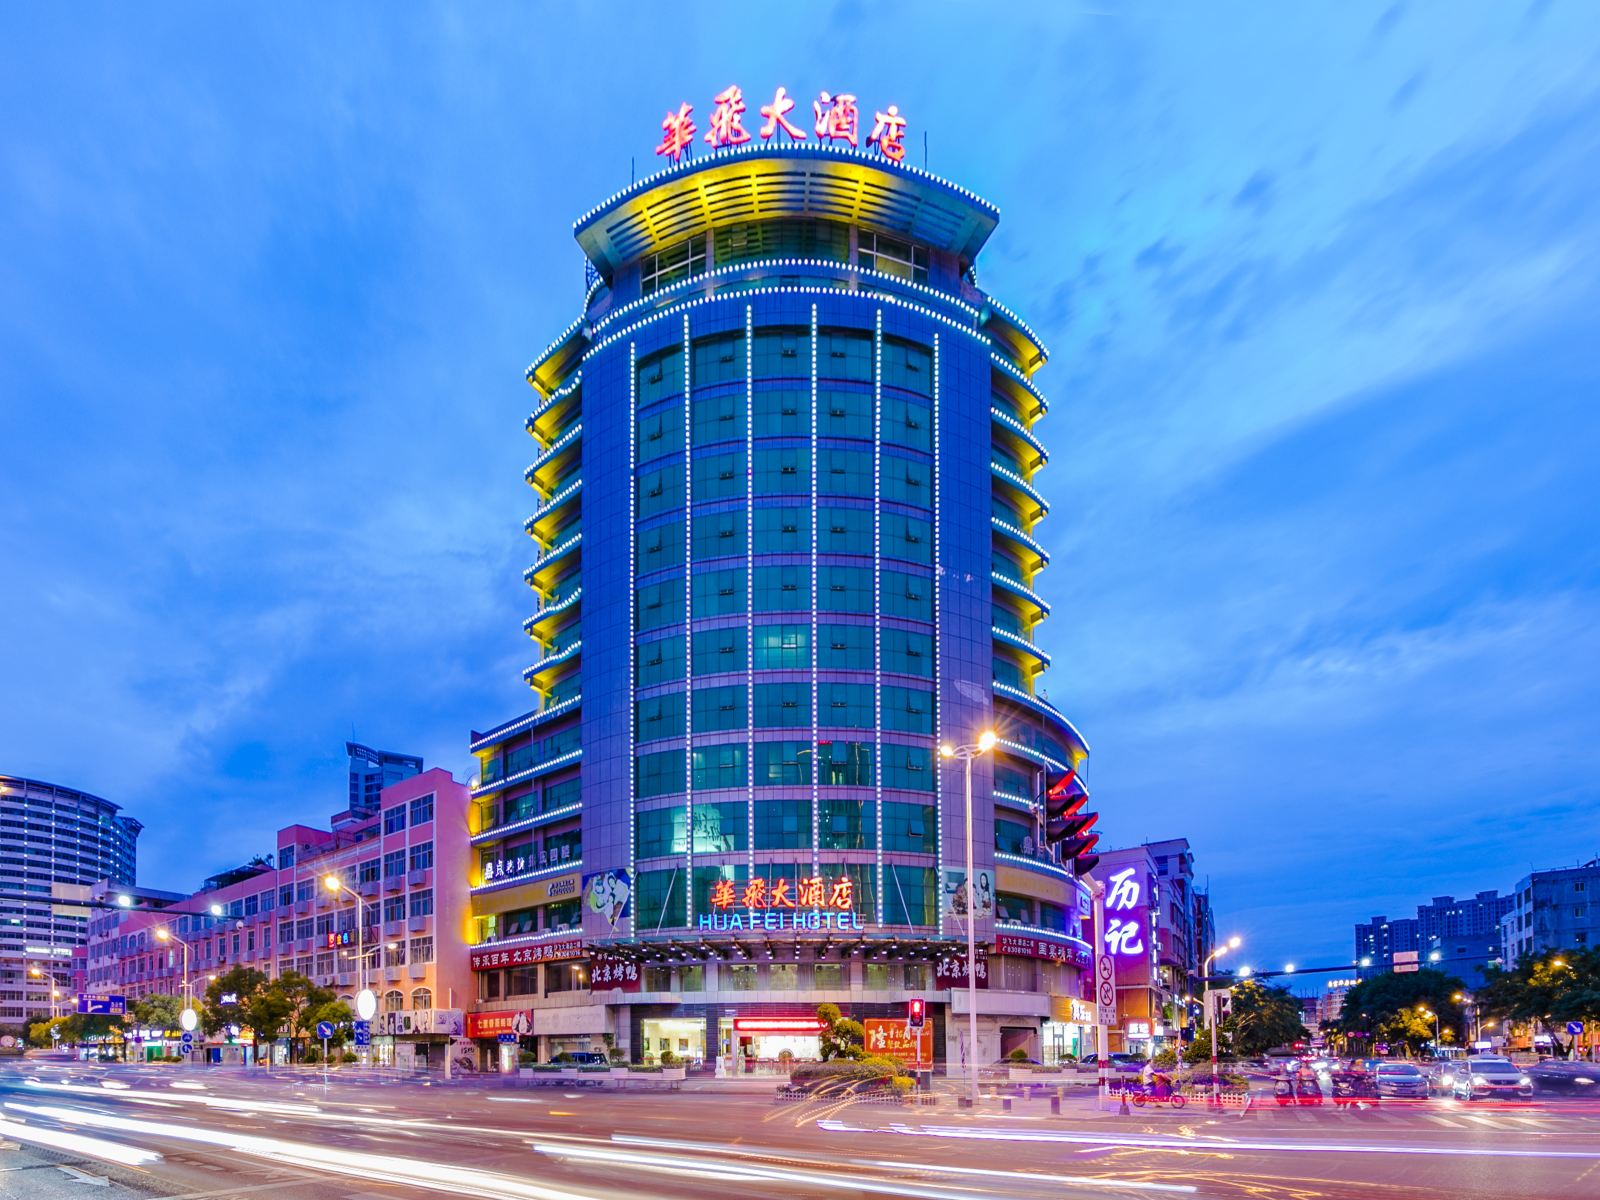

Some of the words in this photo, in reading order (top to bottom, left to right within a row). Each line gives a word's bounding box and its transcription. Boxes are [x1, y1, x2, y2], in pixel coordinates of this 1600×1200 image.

[698, 913, 743, 931] HUA
[749, 912, 784, 930] FEI
[792, 912, 865, 931] HOTEL
[513, 945, 554, 963] 北京烤鸭
[591, 963, 638, 984] 北京烤鸭
